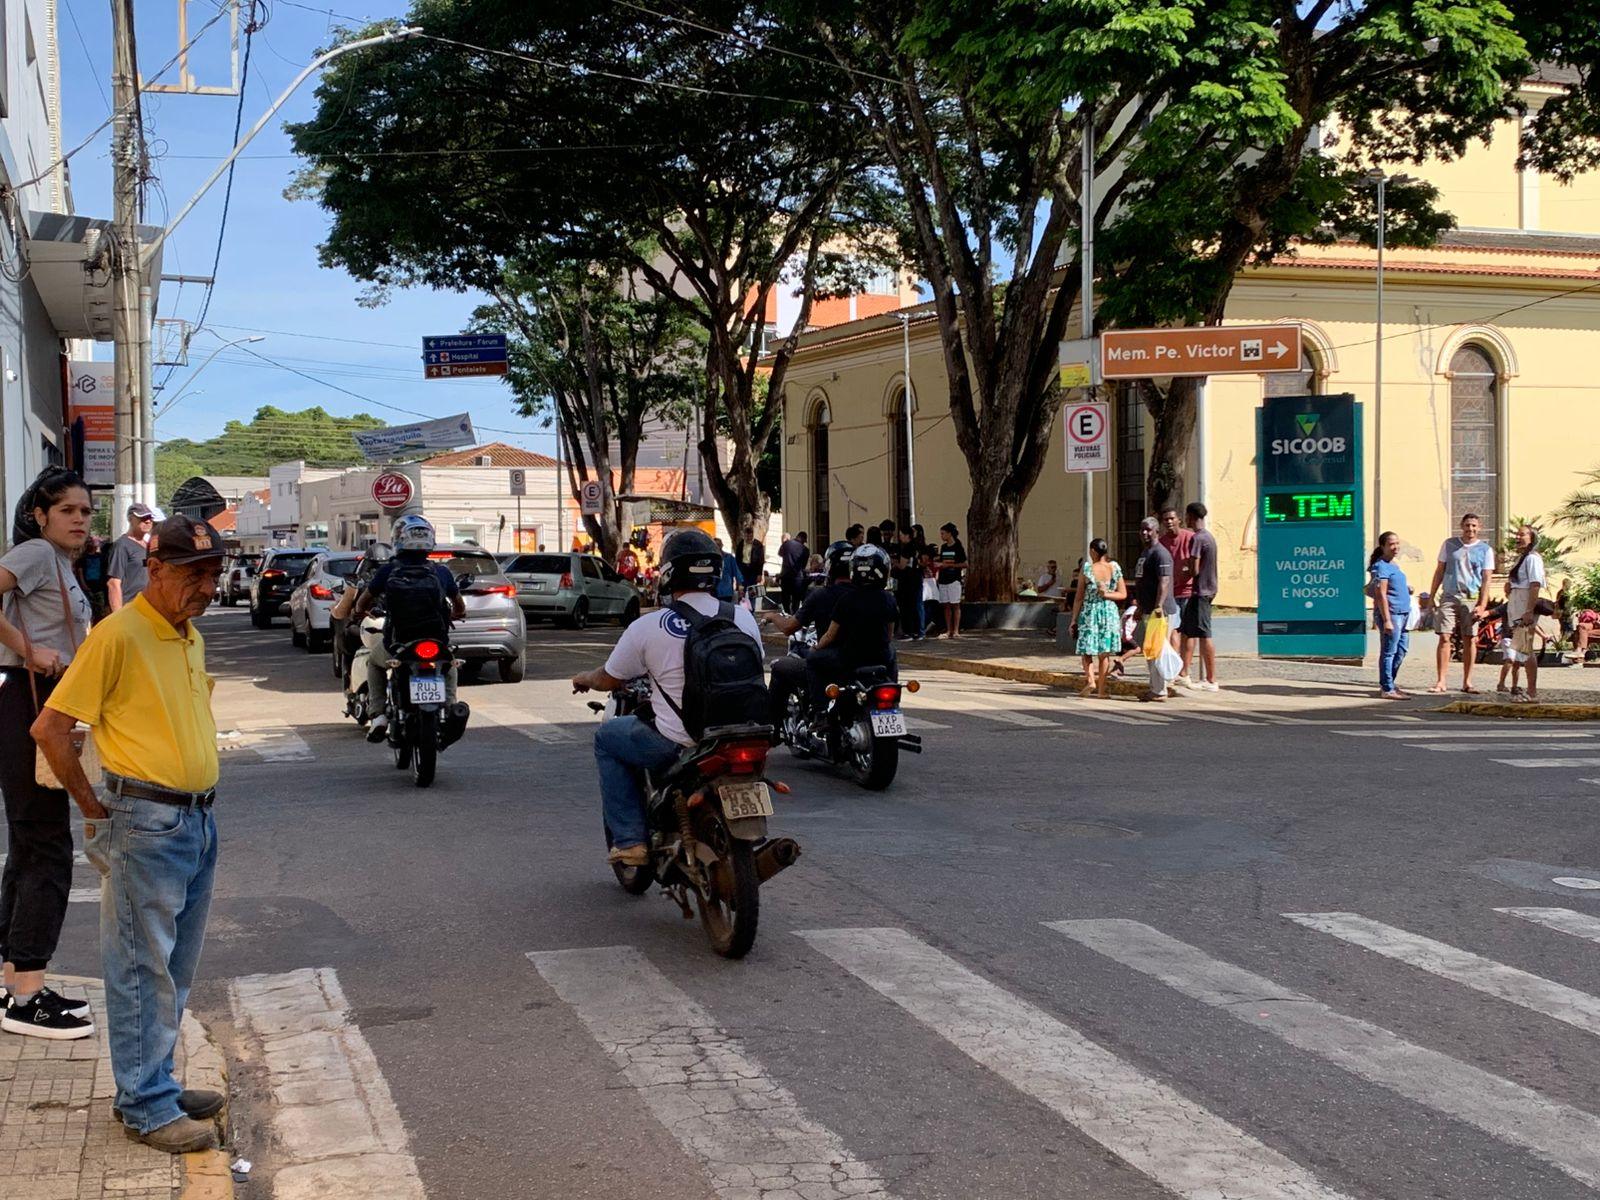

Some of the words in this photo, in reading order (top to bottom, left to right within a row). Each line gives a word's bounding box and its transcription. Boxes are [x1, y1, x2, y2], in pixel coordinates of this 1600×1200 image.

[451, 353, 479, 361] Hospital
[1108, 347, 1150, 360] Mem.
[1155, 346, 1181, 359] Pe.
[1186, 344, 1236, 358] Victor
[1080, 415, 1093, 435] E
[1271, 437, 1346, 455] SICOOB
[514, 473, 521, 482] E
[589, 486, 596, 497] E
[1292, 494, 1352, 518] TEM
[1294, 546, 1326, 556] PARA
[1276, 560, 1345, 571] VALORIZAR
[1291, 574, 1300, 585] O
[1303, 574, 1330, 585] QUE
[1292, 587, 1339, 598] NOSSO!
[417, 682, 438, 691] RUJ
[415, 691, 441, 701] 1G25
